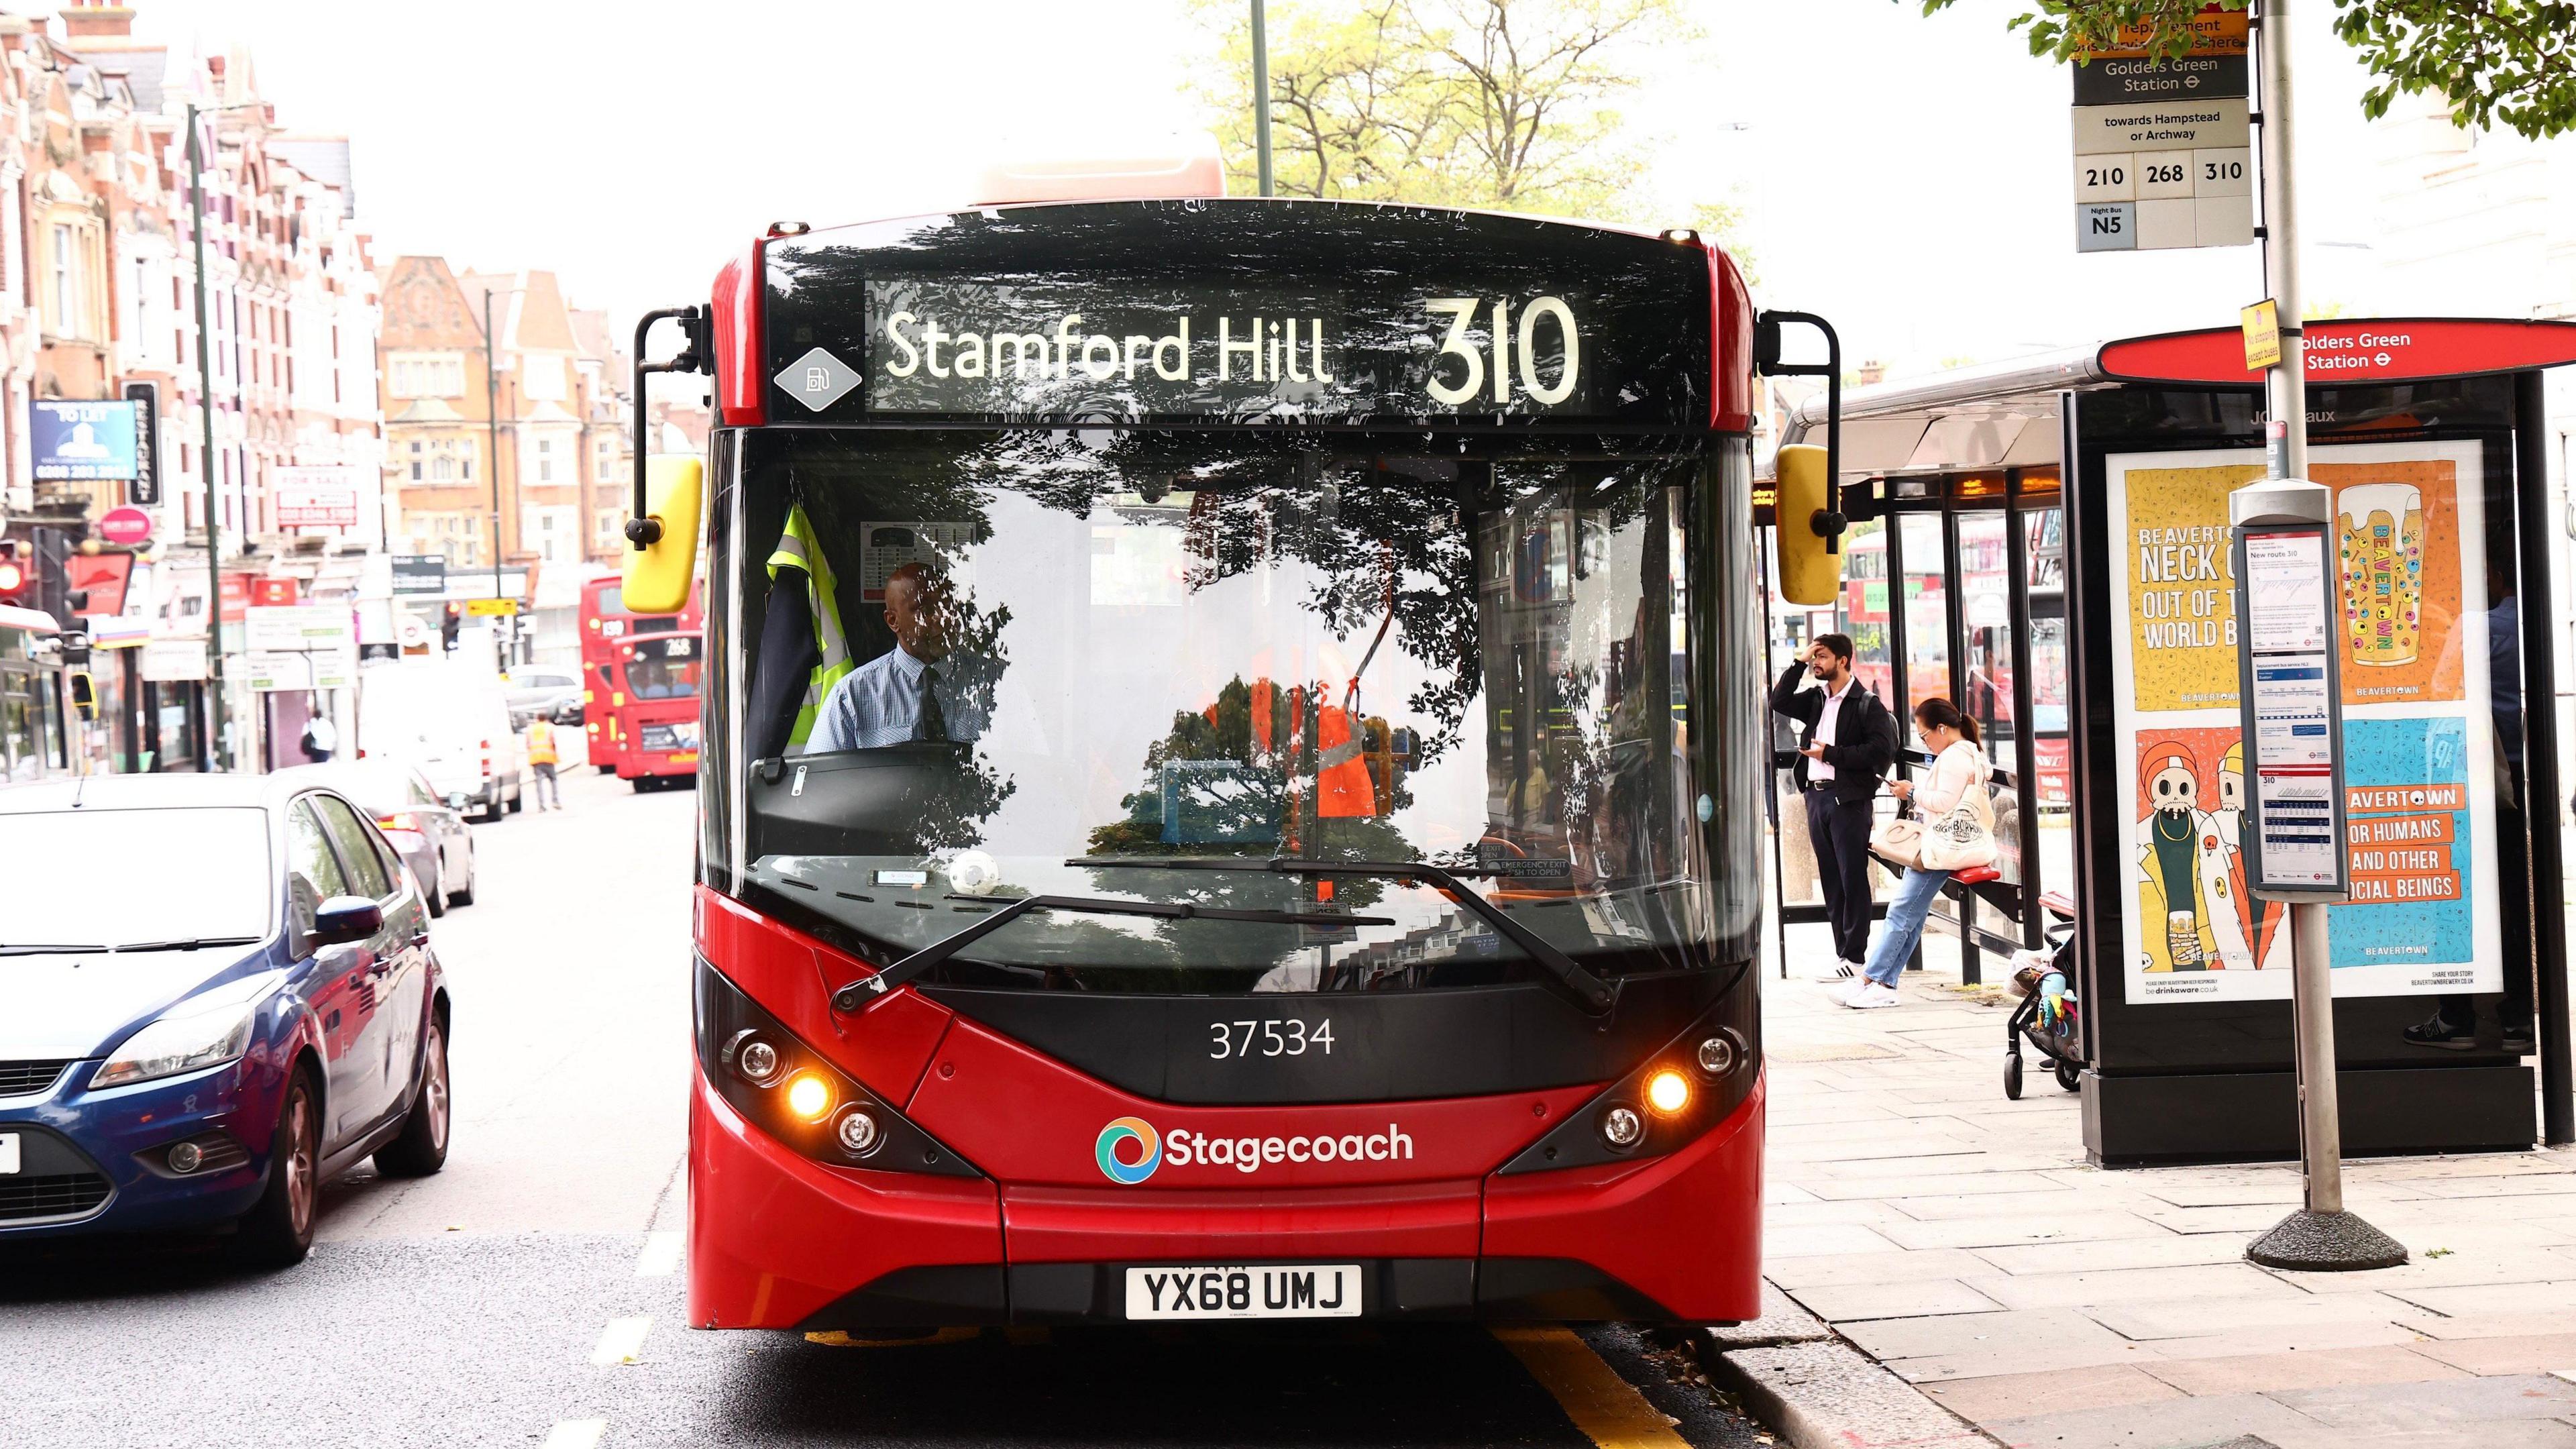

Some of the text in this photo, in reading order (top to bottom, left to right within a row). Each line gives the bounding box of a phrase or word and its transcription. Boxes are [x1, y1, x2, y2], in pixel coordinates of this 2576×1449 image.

[2125, 20, 2220, 35] repement
[2105, 59, 2218, 75] Golders Green
[2125, 78, 2179, 92] Station
[2105, 112, 2220, 127] towards Hampstead
[2131, 129, 2196, 141] or Archway
[2086, 168, 2124, 186] 210
[2147, 165, 2184, 183] 268
[2206, 162, 2242, 180] 310
[2091, 207, 2108, 215] Night
[2092, 217, 2121, 234] N5
[2247, 329, 2275, 345] No stopping
[2302, 333, 2411, 351] olders Green
[885, 311, 1335, 384] Stamford Hill
[1426, 296, 1580, 405] 310
[2248, 347, 2278, 363] except buses
[2308, 354, 2369, 370] Station
[58, 409, 108, 423] TO LET
[2250, 411, 2336, 425] JCaux
[2140, 544, 2219, 583] NECK
[2373, 525, 2393, 650] BEAVERTOWN
[2143, 590, 2184, 619] OUT
[2191, 589, 2219, 617] OF
[2144, 621, 2217, 649] WORLD
[666, 638, 691, 656] 268
[2357, 686, 2419, 696] BEAVERTOWN
[2374, 819, 2441, 843] HUMANS
[2352, 851, 2439, 870] AND OTHER
[2397, 876, 2453, 898] BEINGS
[2190, 951, 2254, 962] BEAVERTOWN
[2365, 946, 2428, 956] BEAVERTOWN
[1210, 1018, 1335, 1059] 37534
[1165, 1123, 1414, 1173] Stagecoach
[1144, 1272, 1343, 1311] YX68 UMJ
